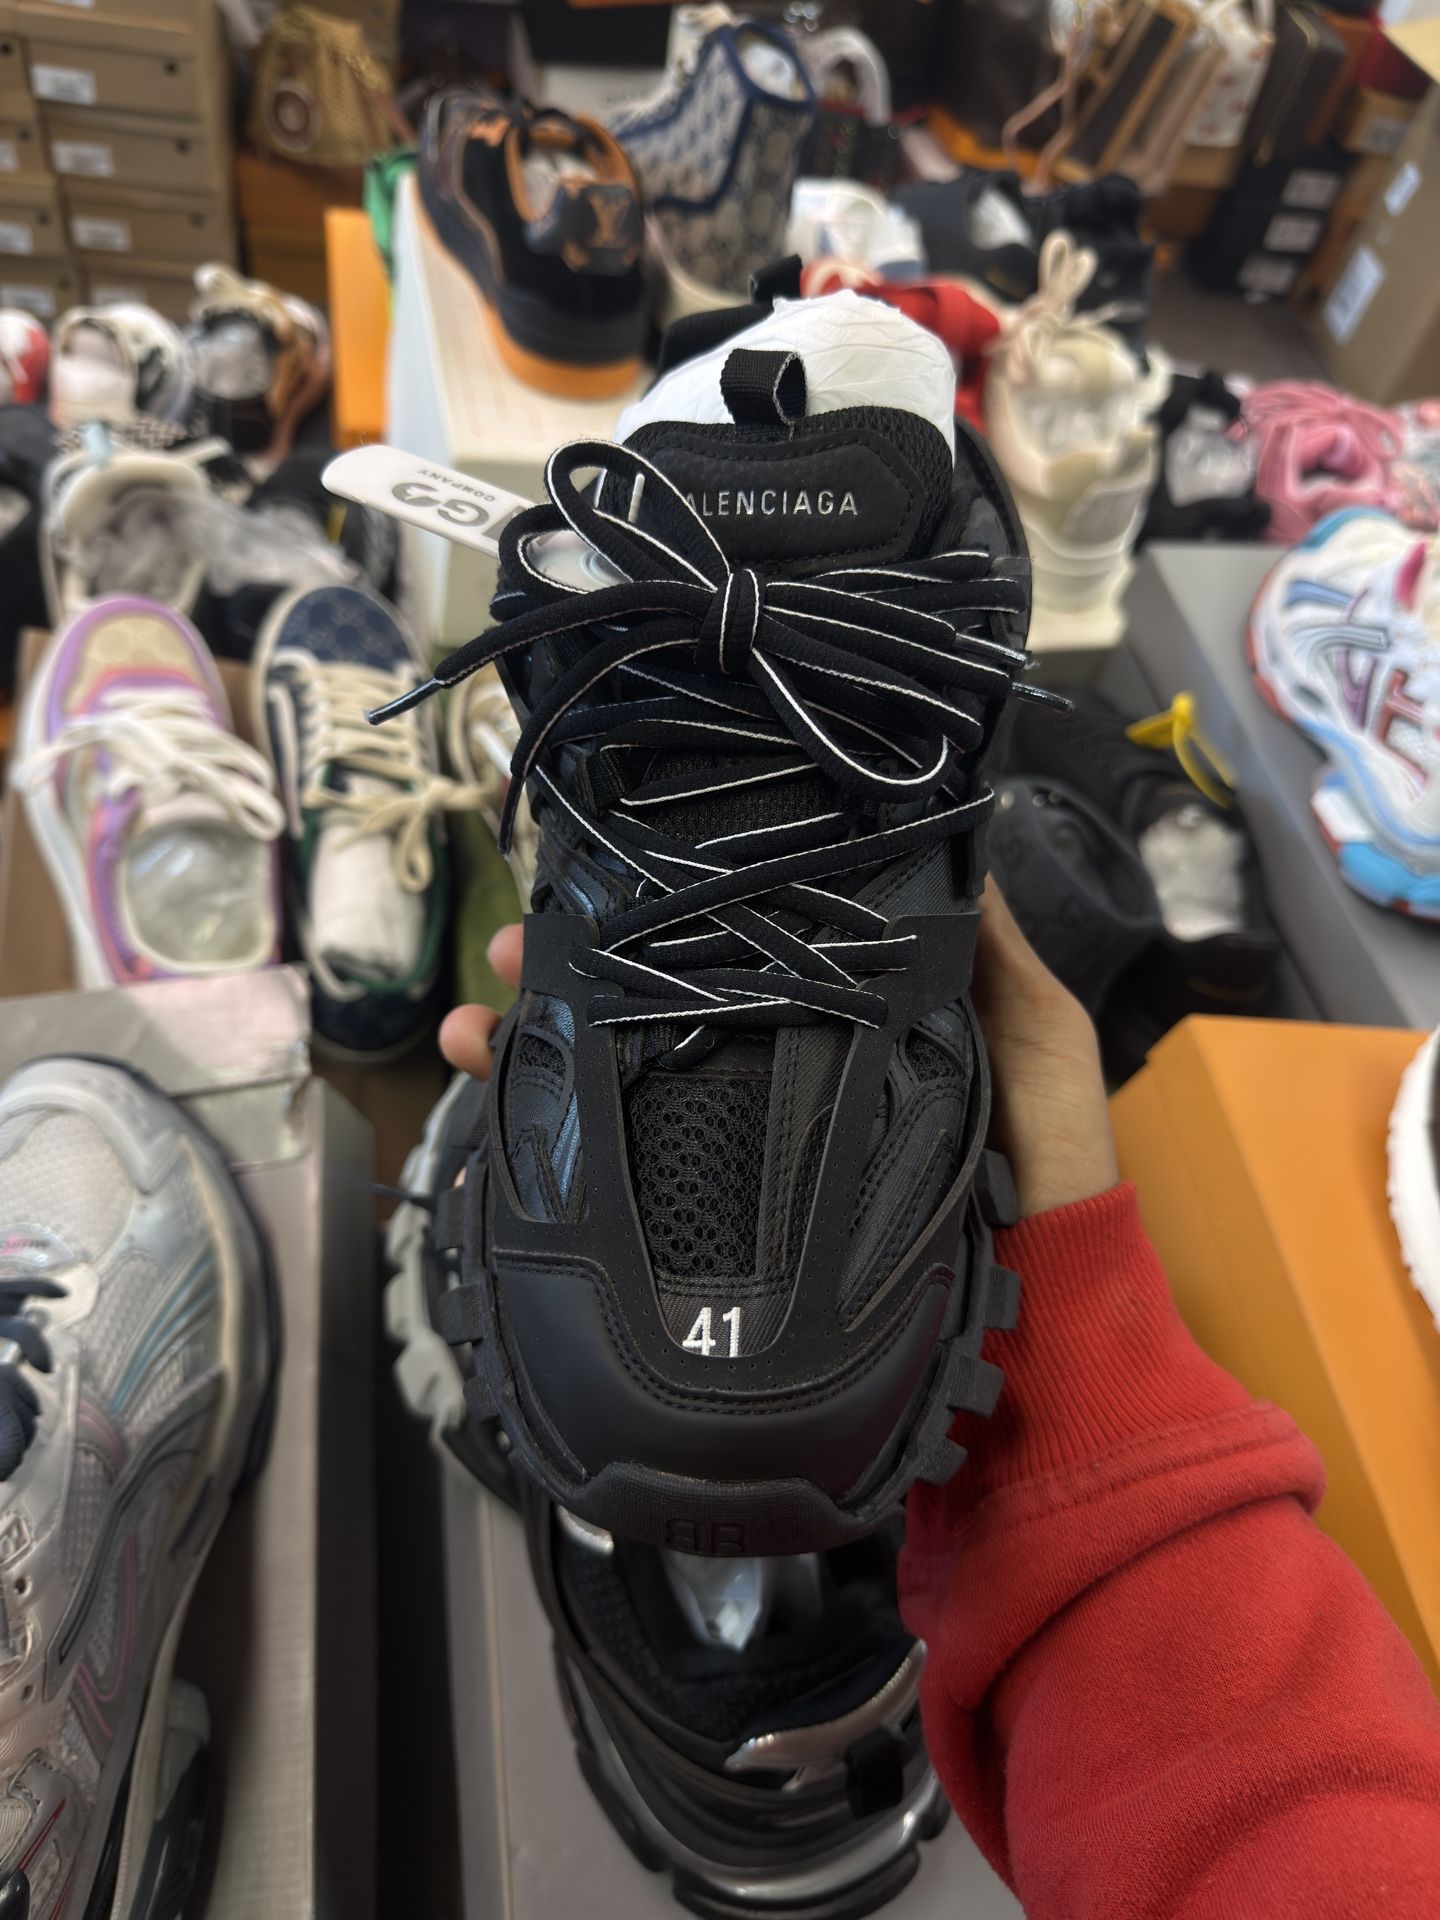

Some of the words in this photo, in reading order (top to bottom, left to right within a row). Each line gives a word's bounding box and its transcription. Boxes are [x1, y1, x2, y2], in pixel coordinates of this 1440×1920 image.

[419, 469, 496, 502] COMPANY
[685, 489, 858, 517] ALENCIAGA
[682, 1306, 741, 1358] 41
